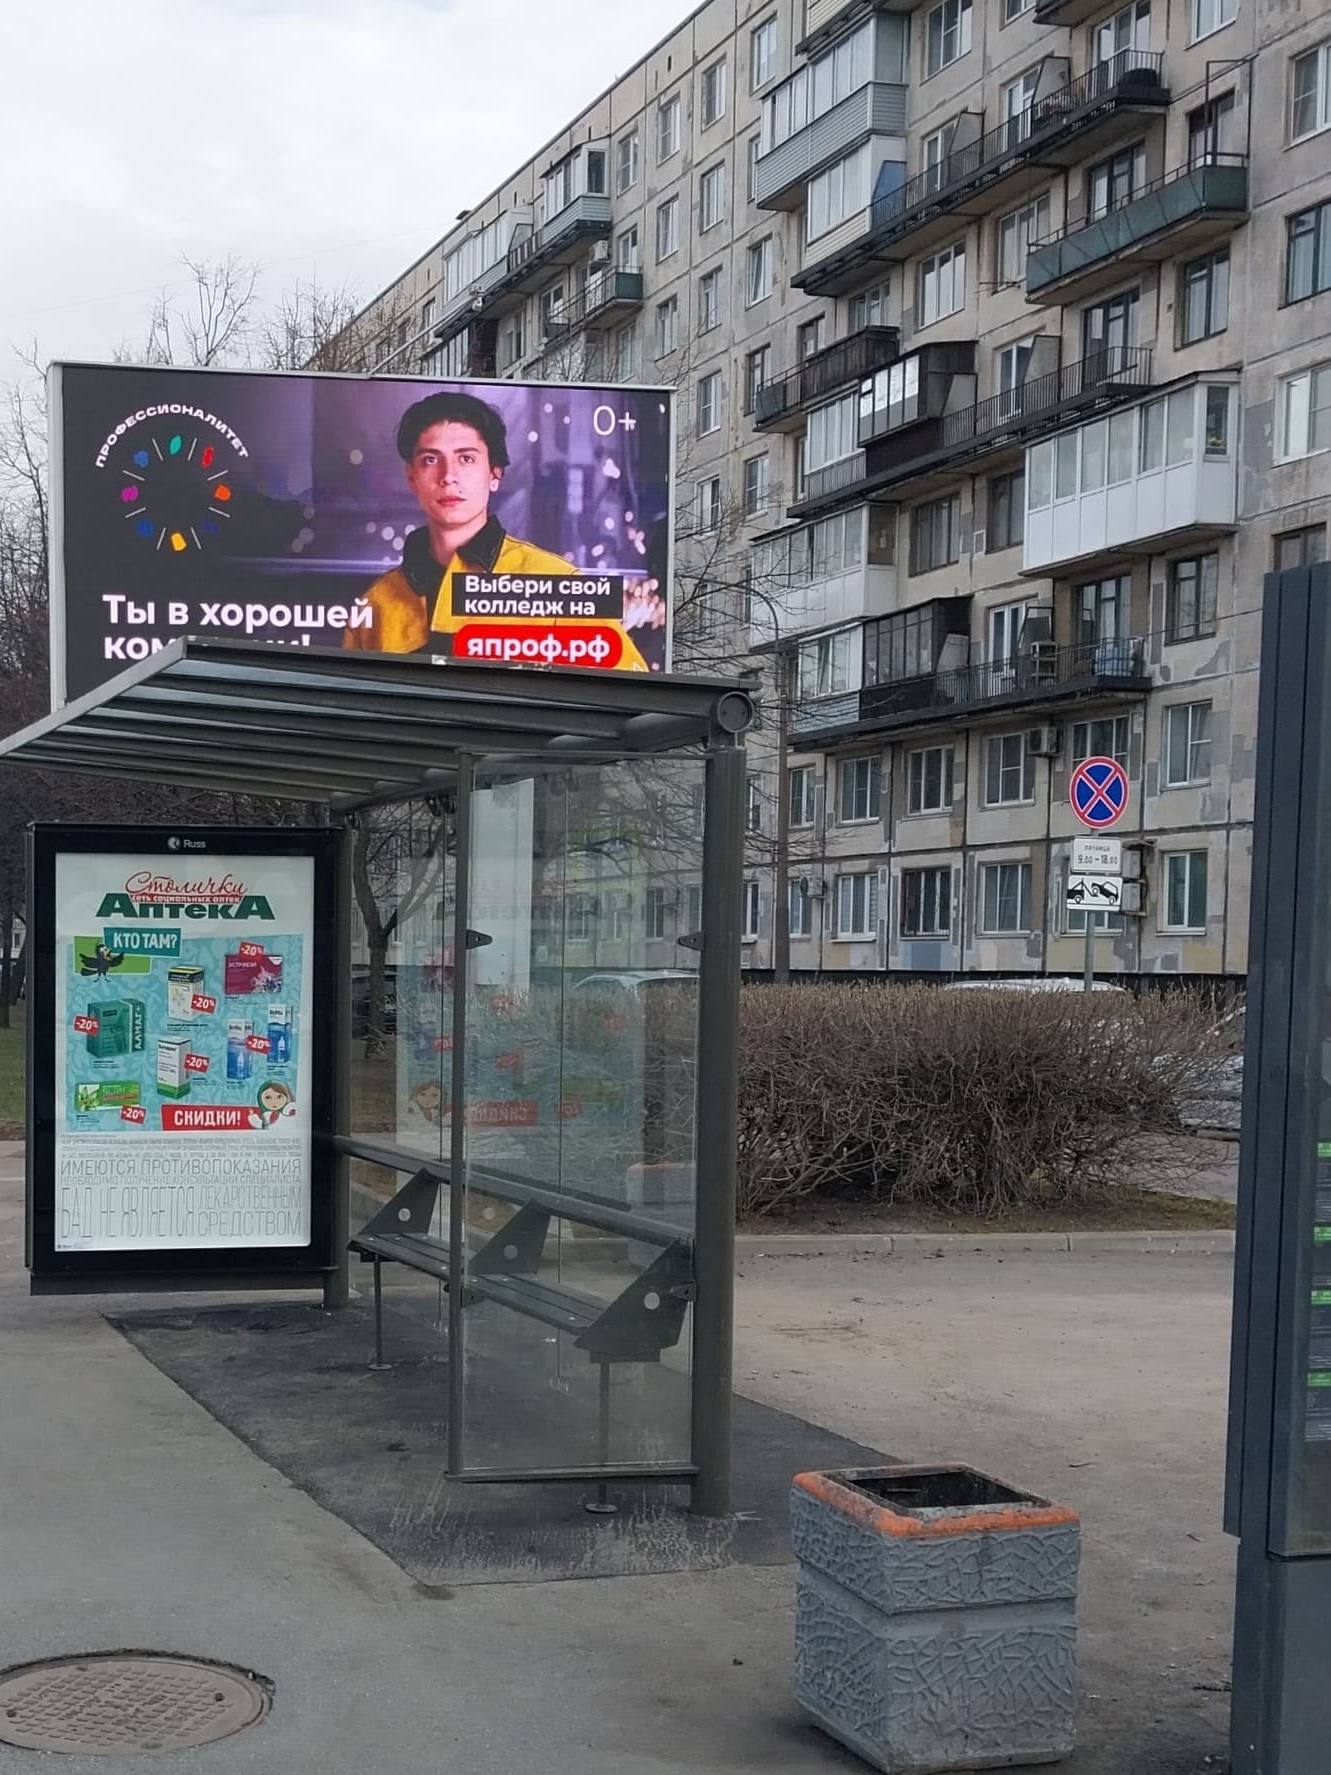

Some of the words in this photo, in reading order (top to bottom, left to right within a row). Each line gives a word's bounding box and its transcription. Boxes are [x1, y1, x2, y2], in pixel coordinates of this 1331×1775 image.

[592, 405, 637, 437] 0+
[95, 403, 249, 469] ПРОФЕССИОНАЛИТЕТ
[465, 575, 552, 597] Выбери
[559, 578, 610, 596] свой
[102, 594, 155, 625] Ты
[168, 602, 189, 625] в
[200, 598, 373, 634] хорошей
[465, 599, 564, 617] колледж
[569, 601, 596, 615] на
[467, 633, 610, 663] япроф.рф
[183, 838, 206, 849] Russ
[125, 871, 248, 895] Столички
[113, 930, 139, 948] КТО
[142, 931, 177, 949] ТАМ?
[174, 1109, 241, 1127] СКИДКИ!
[61, 1159, 135, 1175] ИМЕЮТСЯ
[140, 1159, 300, 1175] ПРОТИВОПОКАЗАНИЯ
[61, 1187, 92, 1238] БАД
[100, 1187, 117, 1238] НЕ
[121, 1186, 194, 1237] ЯВЛЯЕТСЯ
[197, 1211, 301, 1237] СРЕДСТВОМ
